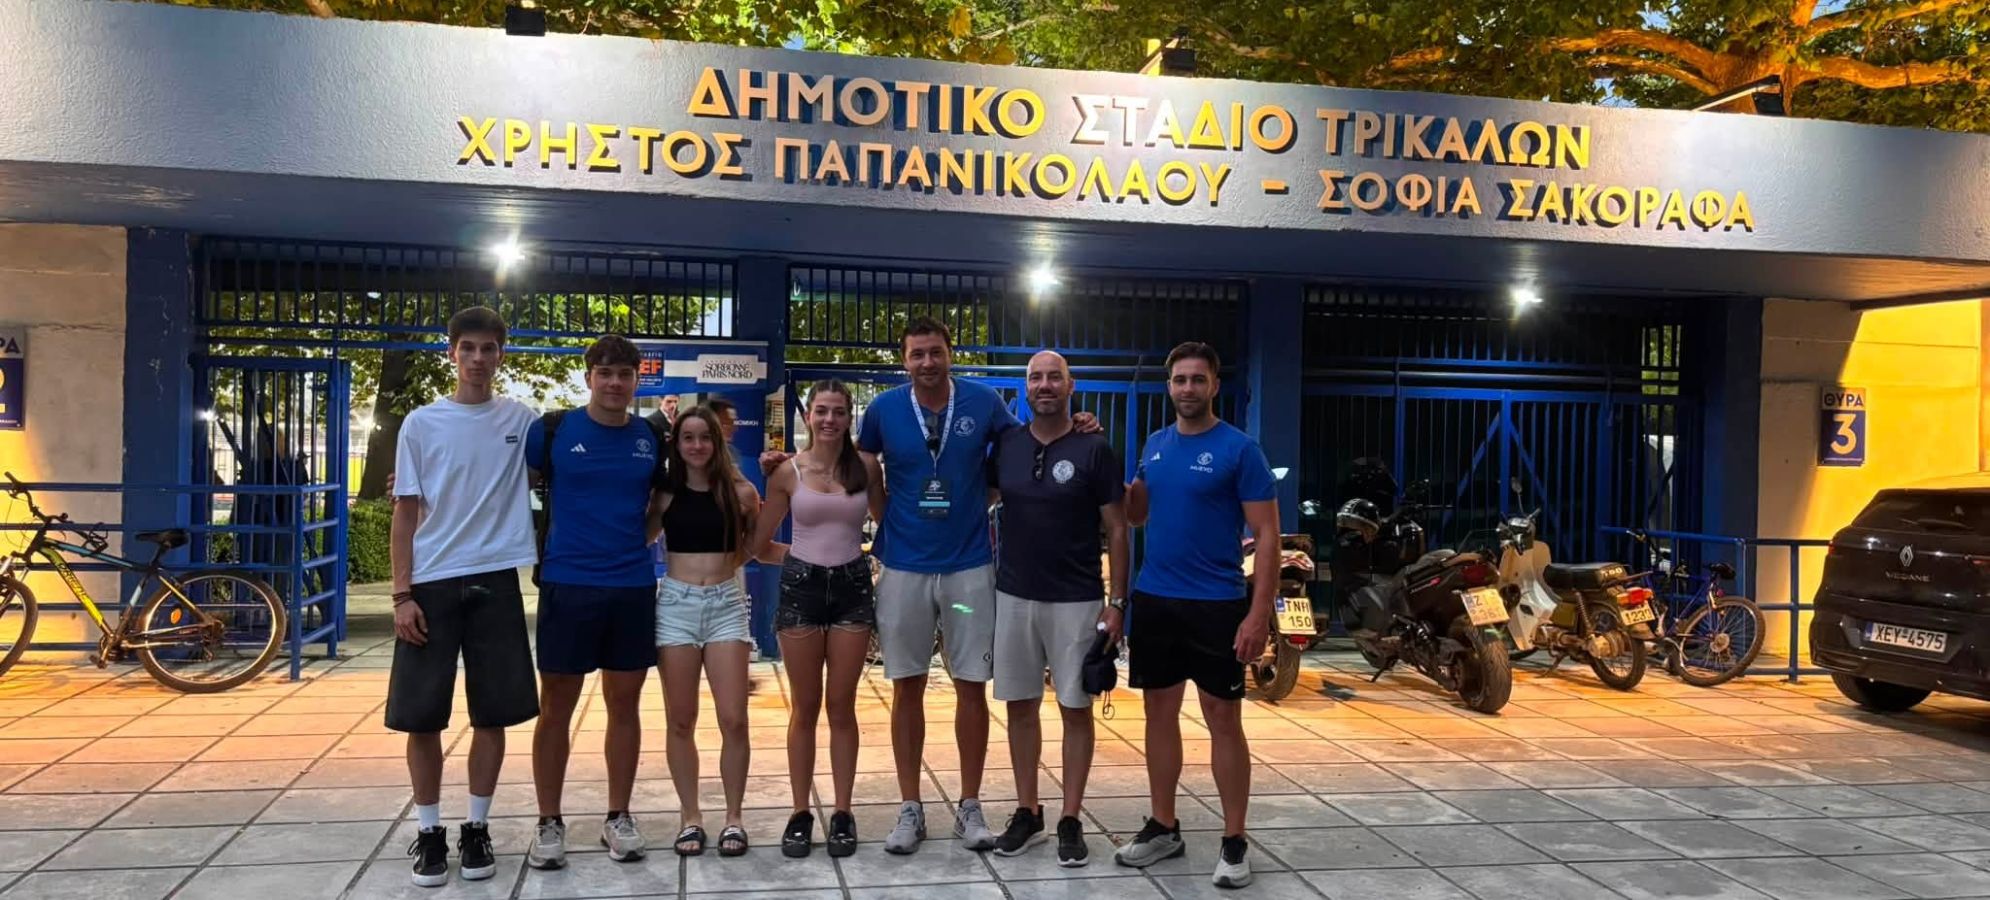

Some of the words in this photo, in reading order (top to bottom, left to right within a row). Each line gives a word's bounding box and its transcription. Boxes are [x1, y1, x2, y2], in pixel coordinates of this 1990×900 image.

[687, 67, 1045, 138] ΔΗΜΟΤΙΚΟ
[1070, 95, 1293, 153] ΣΤΑΔΙΟ
[1316, 108, 1590, 169] ΤΡΙΚΑΛΩΝ
[459, 116, 744, 176] ΧΡΗΣΤΟΣ
[774, 137, 1231, 202] ΠΑΠΑΝΙΚΟΛΑΟΥ
[1317, 169, 1481, 214] ΣΟΦΙΑ
[1507, 179, 1754, 229] ΣΑΚΟΡΑΦΑ
[702, 370, 727, 378] PARIS
[728, 370, 753, 379] NORD
[1824, 393, 1864, 406] ΘΥΡΑ
[1830, 413, 1857, 455] 3
[1288, 615, 1313, 628] 150
